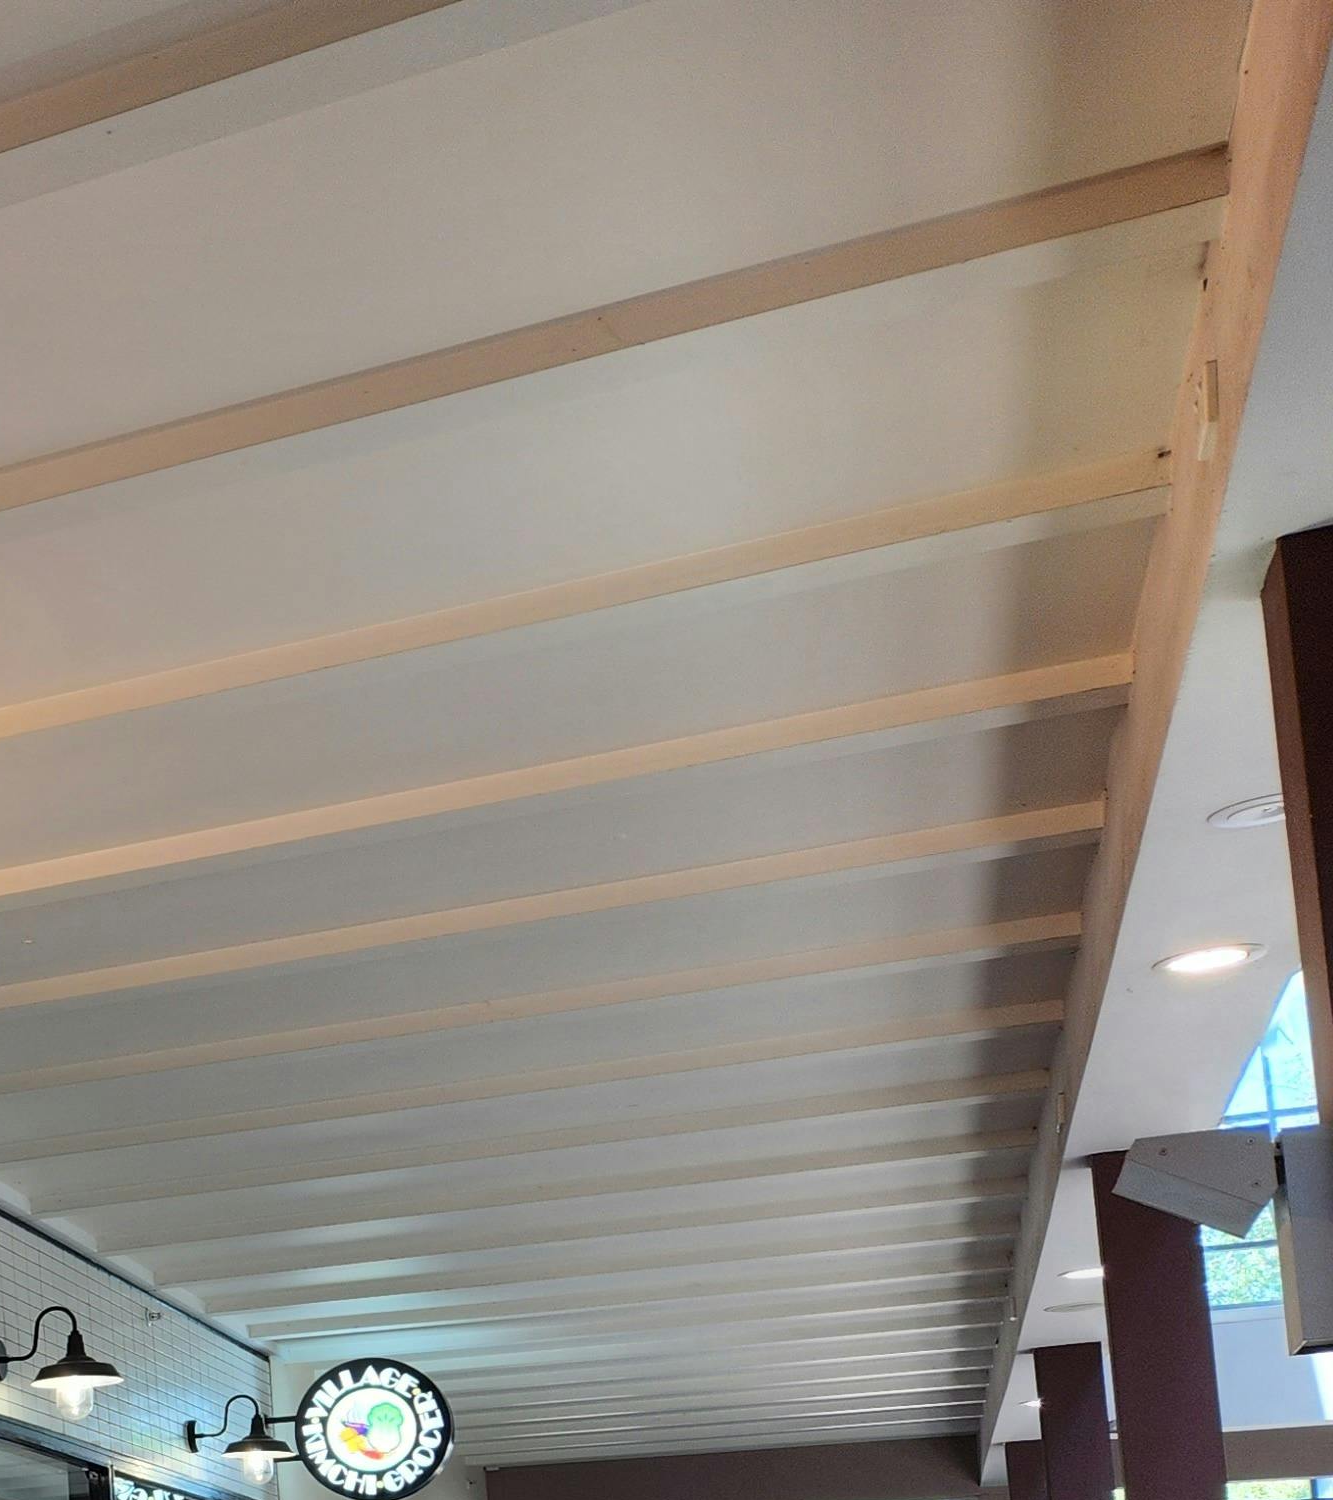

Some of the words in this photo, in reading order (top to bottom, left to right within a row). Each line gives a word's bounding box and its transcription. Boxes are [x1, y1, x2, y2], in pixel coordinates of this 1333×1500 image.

[304, 1365, 420, 1420] VILLAGE
[301, 1422, 378, 1496] KIMCHI
[383, 1390, 445, 1493] GROCER
